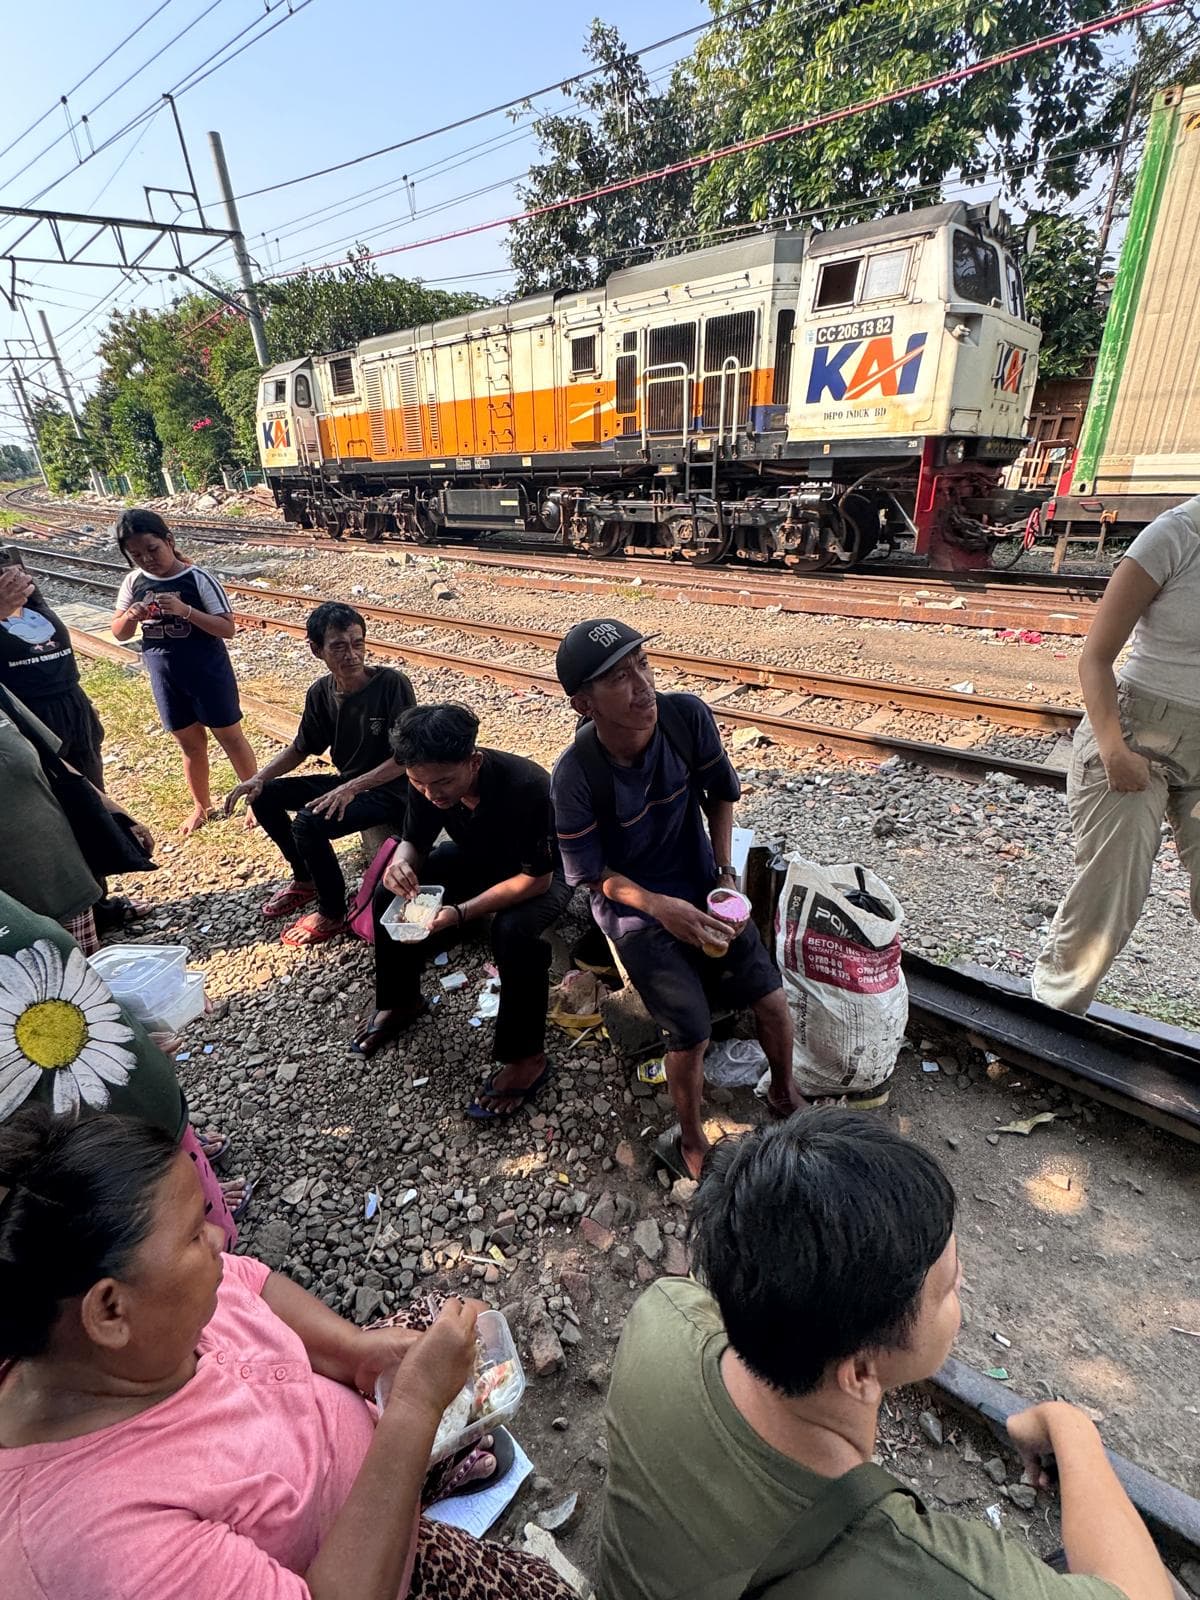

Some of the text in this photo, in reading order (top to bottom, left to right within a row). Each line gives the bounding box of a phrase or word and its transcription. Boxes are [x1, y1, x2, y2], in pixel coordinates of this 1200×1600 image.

[818, 327, 836, 342] CC
[837, 325, 859, 340] 206
[861, 321, 874, 336] 13
[876, 317, 891, 334] 82
[806, 332, 928, 404] KAI
[993, 343, 1028, 394] KAI
[823, 411, 843, 421] DEPO
[262, 419, 291, 449] KAI
[588, 623, 617, 642] GOOD
[599, 630, 622, 647] DAY
[808, 937, 843, 952] BETON
